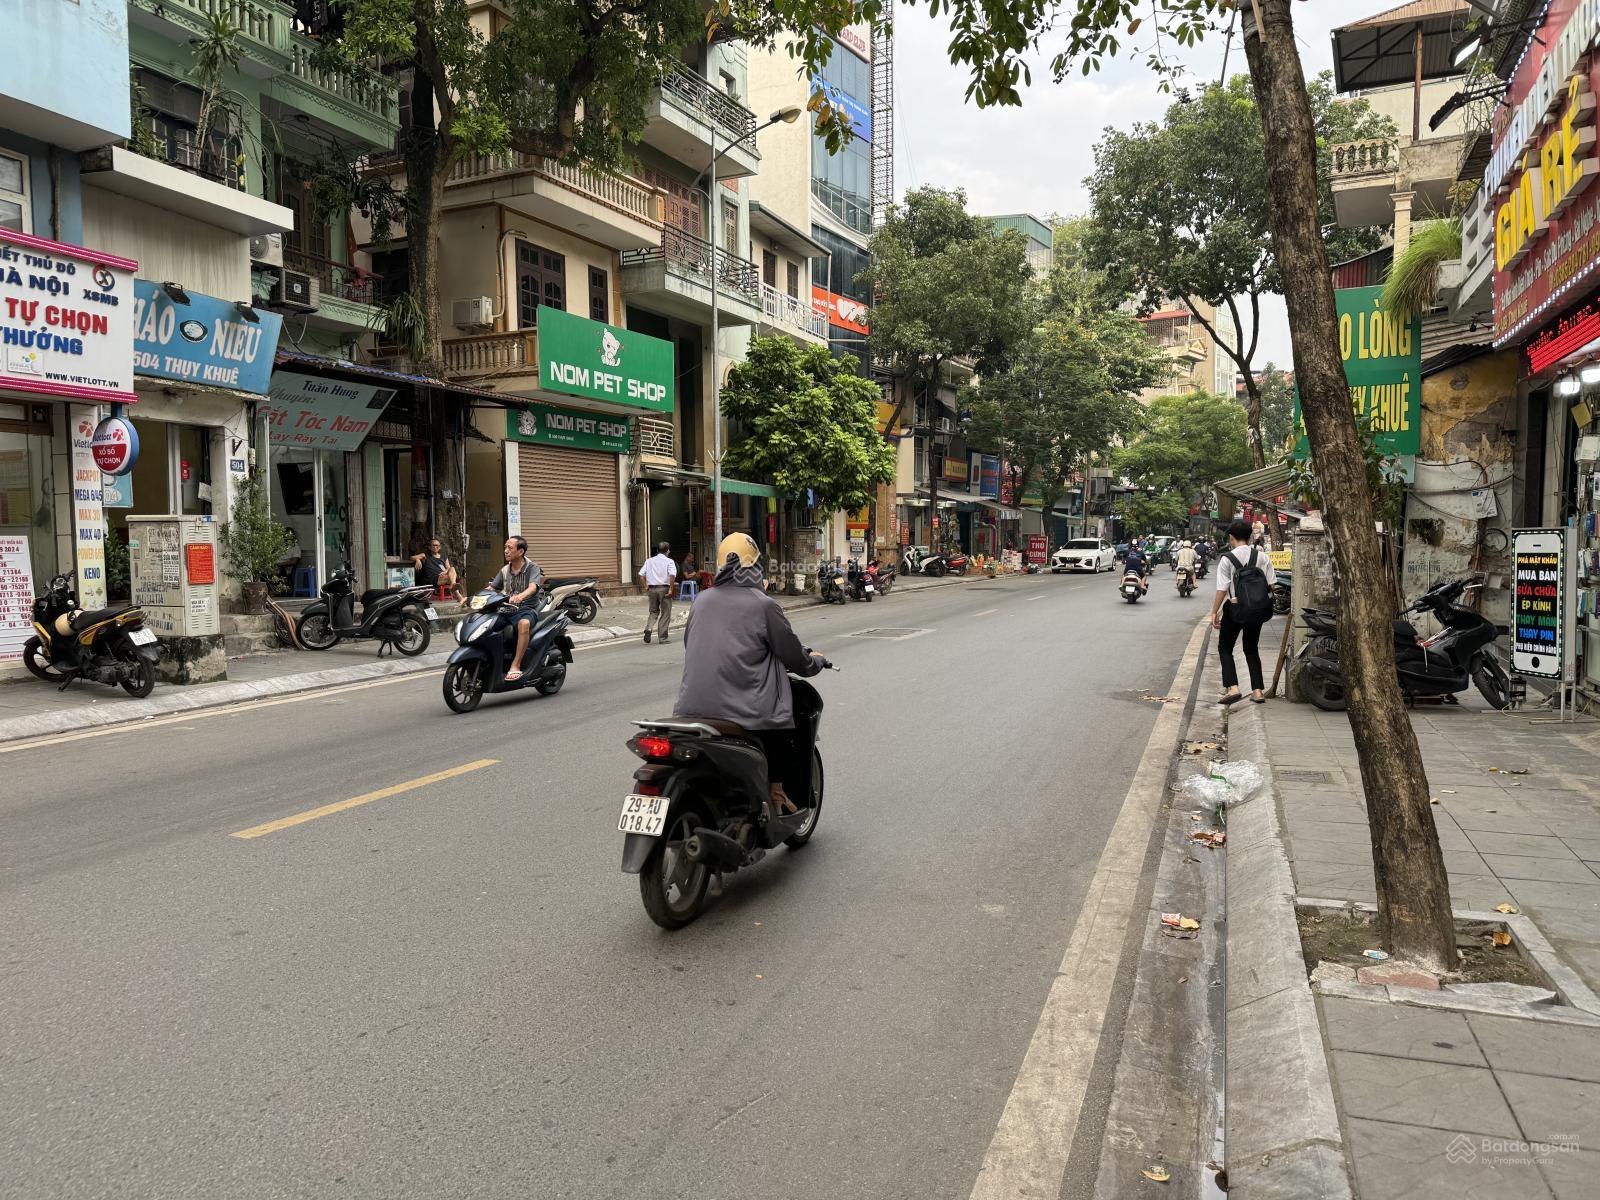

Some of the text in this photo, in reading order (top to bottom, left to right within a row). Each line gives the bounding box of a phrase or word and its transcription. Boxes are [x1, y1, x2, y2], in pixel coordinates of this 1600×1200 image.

[1496, 150, 1536, 272] GIÁ
[1540, 75, 1583, 220] RẺ
[24, 253, 53, 271] THỦ
[56, 262, 76, 276] ĐÔ
[29, 274, 70, 297] NỘI
[83, 288, 119, 307] XSMB
[5, 296, 108, 336] TỰ CHỌN
[1358, 299, 1412, 360] LÒNG
[134, 351, 239, 385] 504 THỤY KHUÊ
[45, 371, 119, 389] WWW.VIETLOTT.VN
[550, 361, 666, 402] NOM PET SHOP
[1370, 373, 1410, 432] KHUÊ
[295, 411, 328, 430] Tóc
[329, 415, 369, 433] Nam
[546, 413, 627, 438] NOM PET SHOP
[76, 469, 99, 481] JACKPOT
[75, 489, 91, 501] MEGA
[79, 509, 91, 520] MAX
[80, 529, 92, 540] MAX
[84, 568, 101, 580] KENO
[1518, 567, 1557, 581] MUA BÁN
[1517, 583, 1557, 597] SỬA CHỮA
[1522, 598, 1551, 611] ÉP KÍNH
[1516, 614, 1535, 625] THAY
[1519, 628, 1554, 641] THAY PIN
